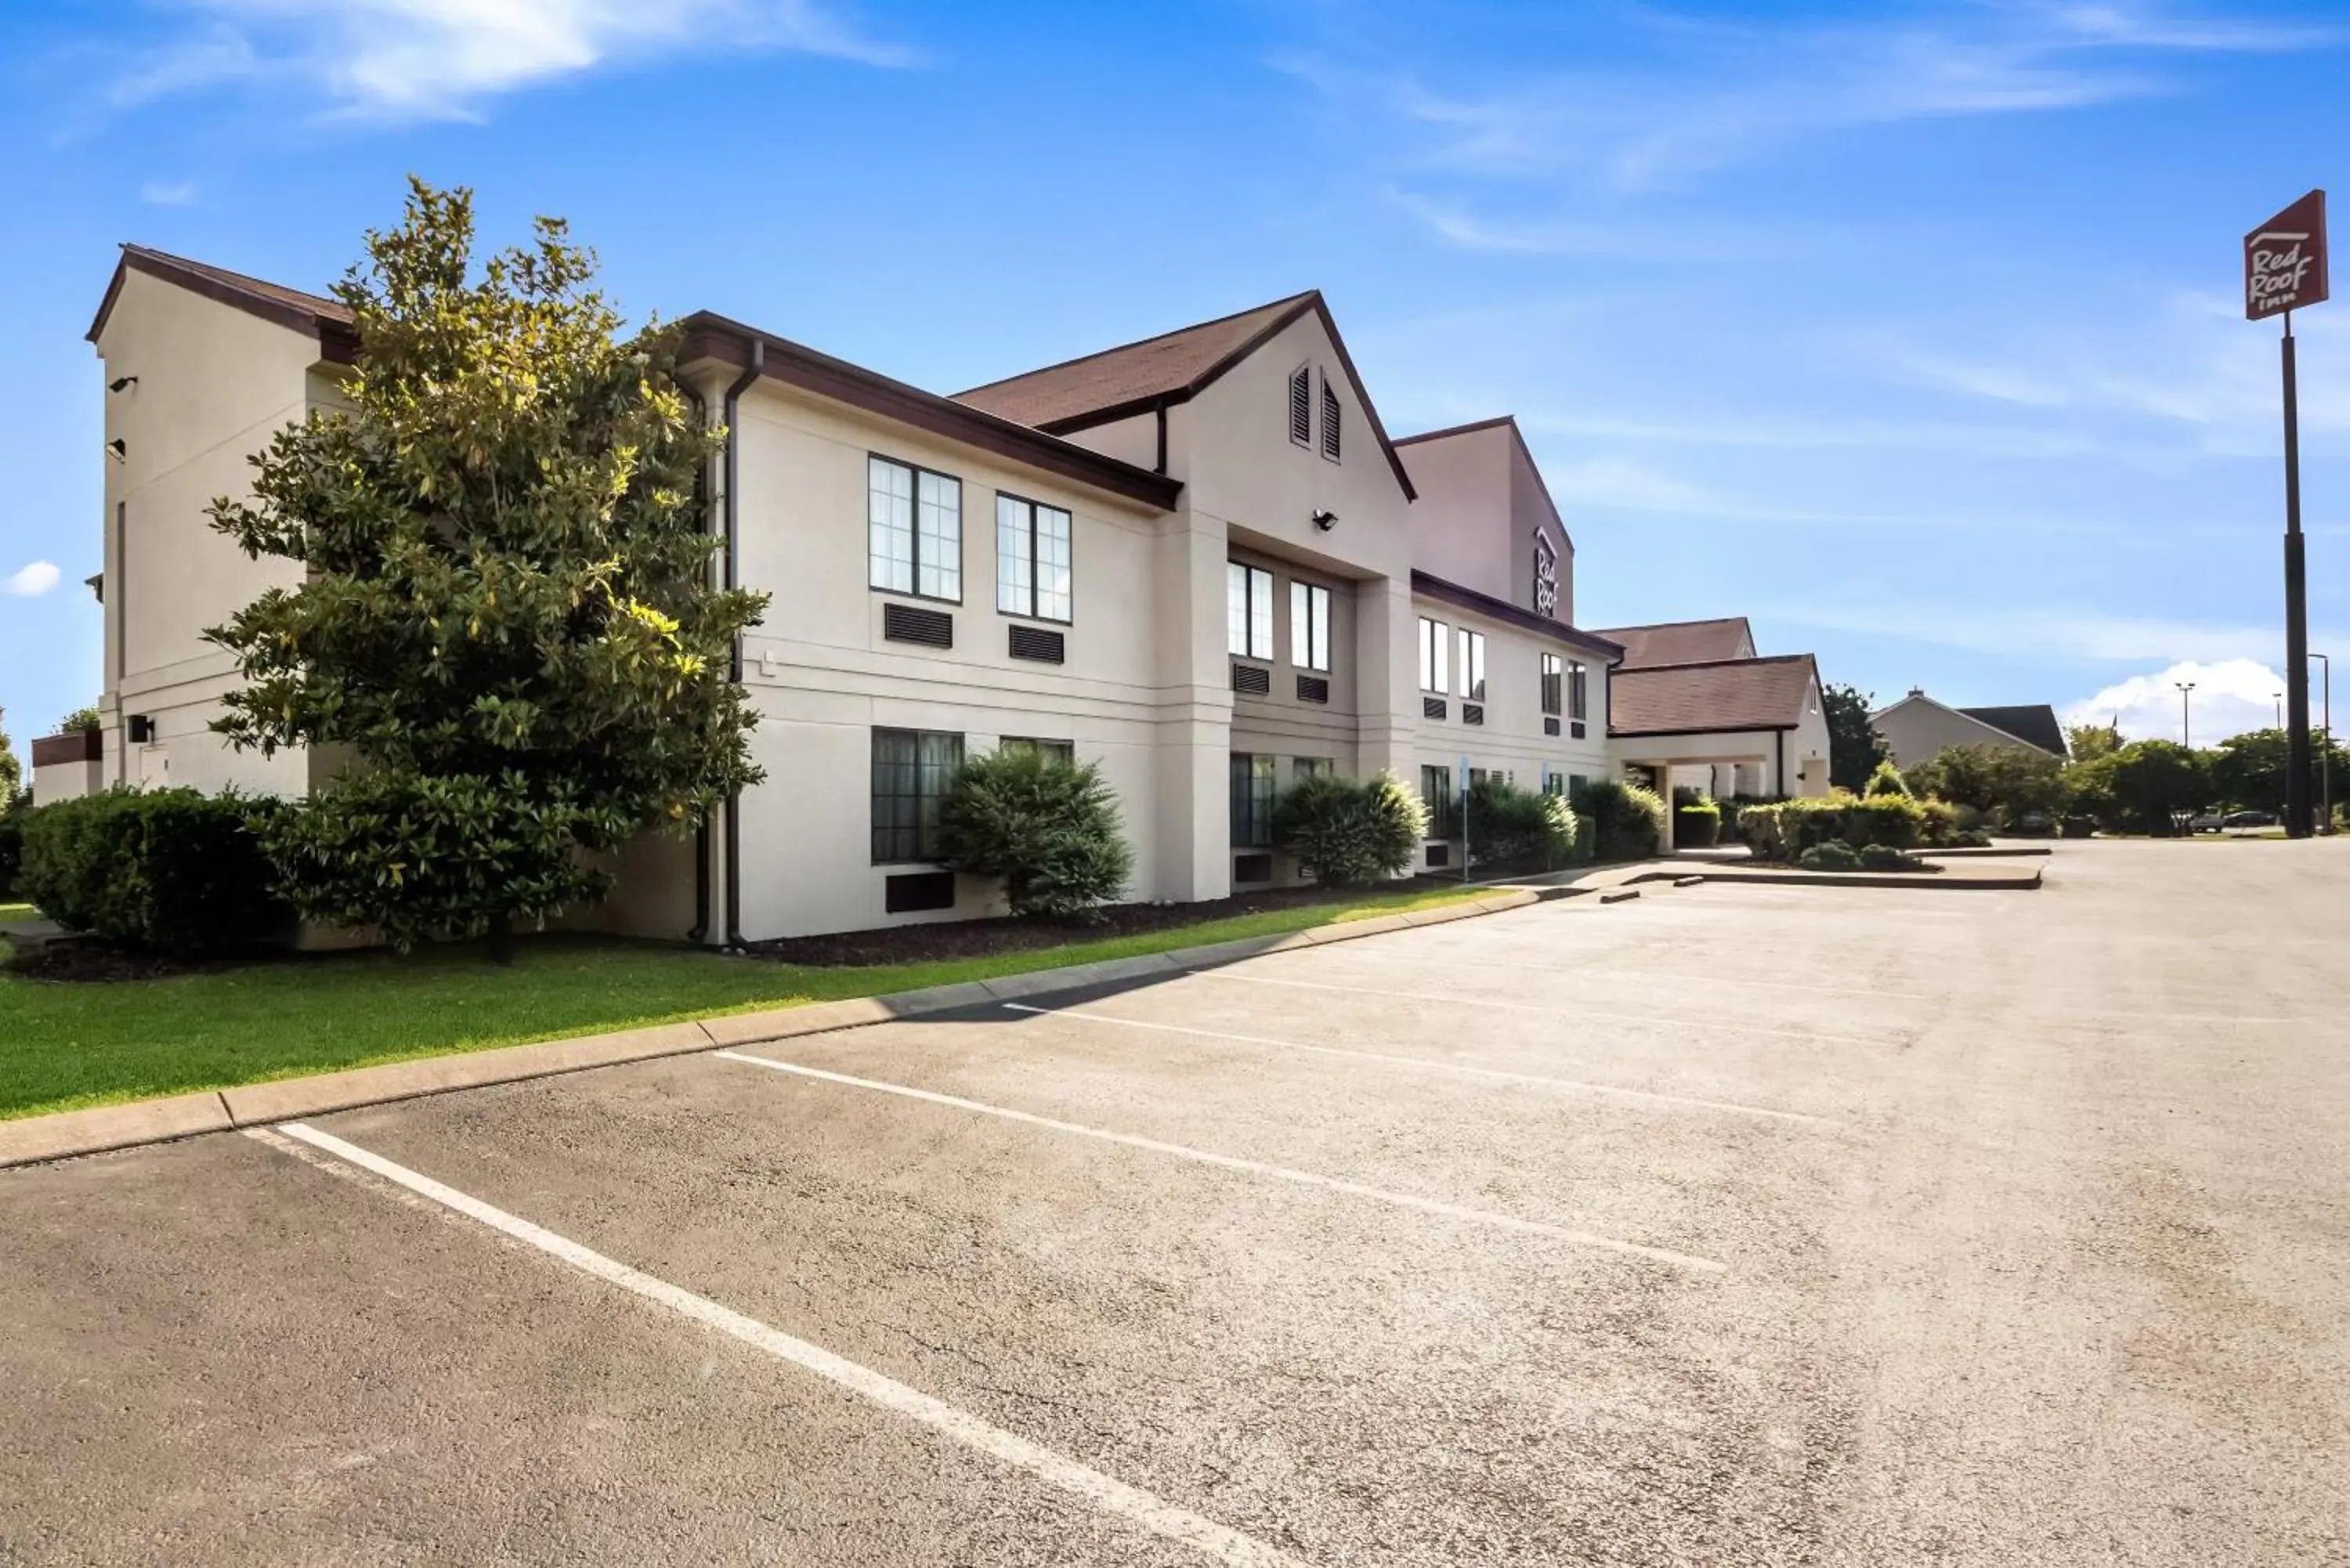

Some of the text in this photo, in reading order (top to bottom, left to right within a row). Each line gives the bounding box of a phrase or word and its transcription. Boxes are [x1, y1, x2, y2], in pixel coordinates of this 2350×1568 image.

[2252, 243, 2301, 274] Red
[2249, 255, 2314, 304] Roof
[1538, 547, 1555, 583] Red
